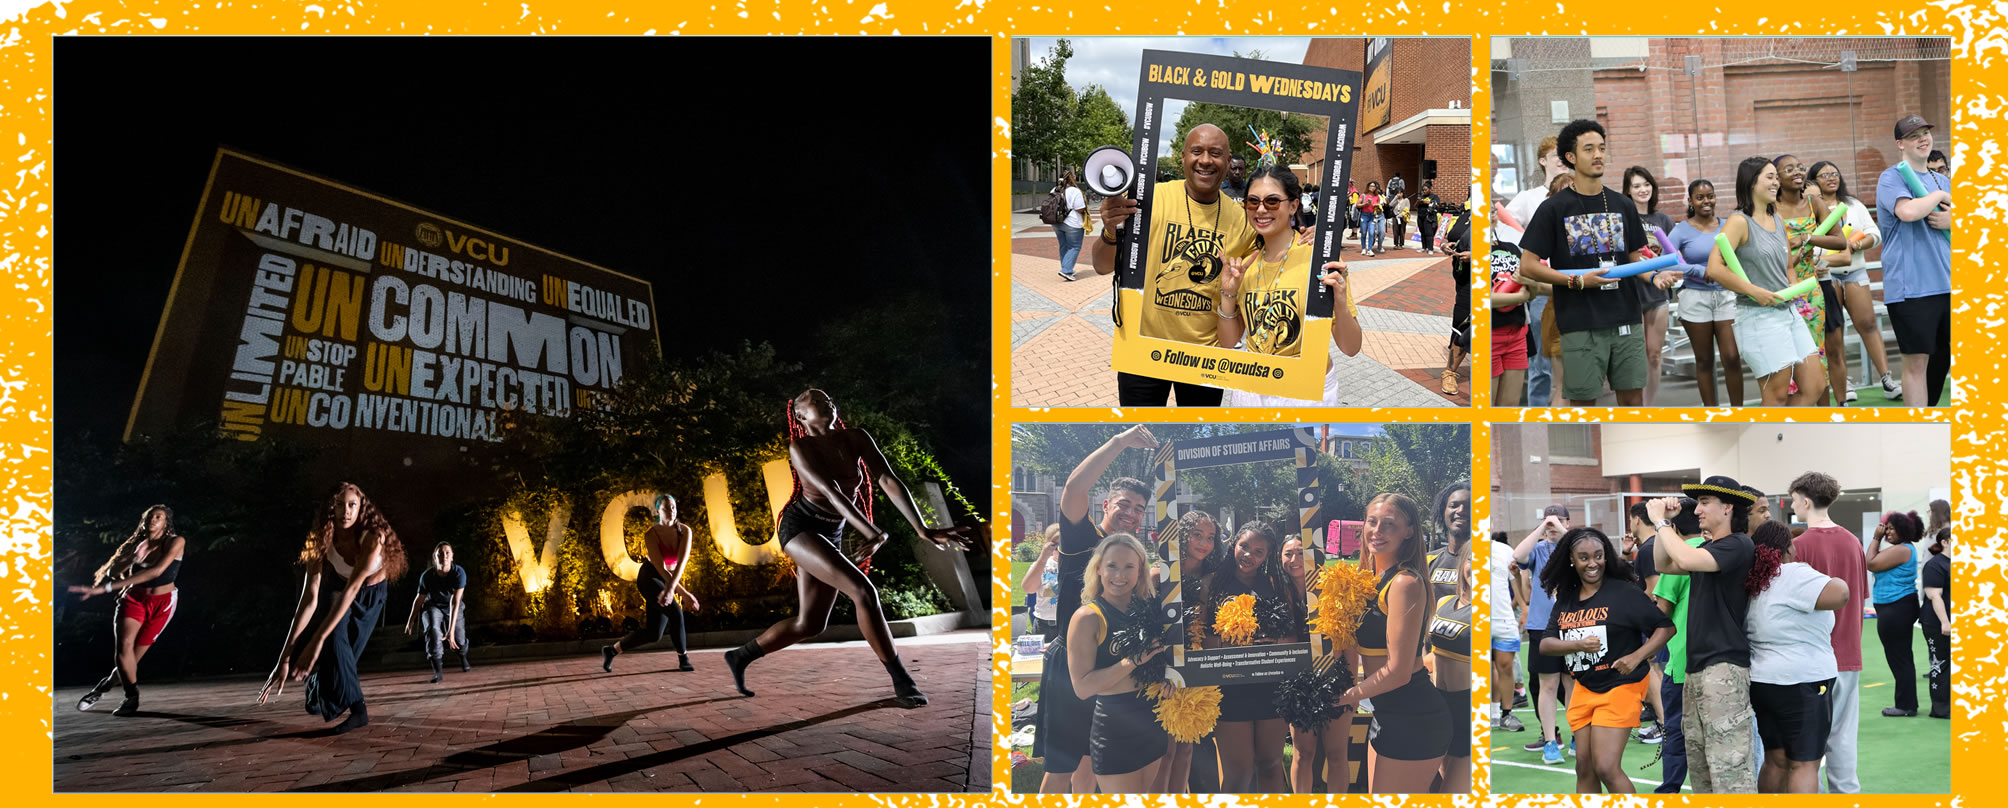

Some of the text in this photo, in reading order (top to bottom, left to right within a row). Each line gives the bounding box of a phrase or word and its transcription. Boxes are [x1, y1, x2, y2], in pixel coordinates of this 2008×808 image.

[1149, 64, 1351, 103] BLACK & GOLD WEDNESDAYS
[219, 191, 377, 261] UNAFRAID
[1162, 223, 1224, 263] BLACK
[444, 230, 509, 266] VCU
[1185, 240, 1220, 259] GOLD
[380, 240, 537, 304] UNDERSTANDING
[542, 273, 650, 331] UNEQUALED
[1156, 292, 1212, 311] WEDNESDAYS
[218, 253, 297, 442] UNLIMITED
[284, 335, 357, 367] UNSTOP
[1163, 349, 1270, 378] Follow us @vcudsa
[279, 360, 346, 392] PABLE
[364, 341, 572, 418] UNEXPECTED
[1178, 438, 1291, 461] DIVISION OF STUDENT AFFAIRS
[502, 457, 797, 593] VCU
[1431, 569, 1458, 583] RAM
[1429, 616, 1464, 638] VCU
